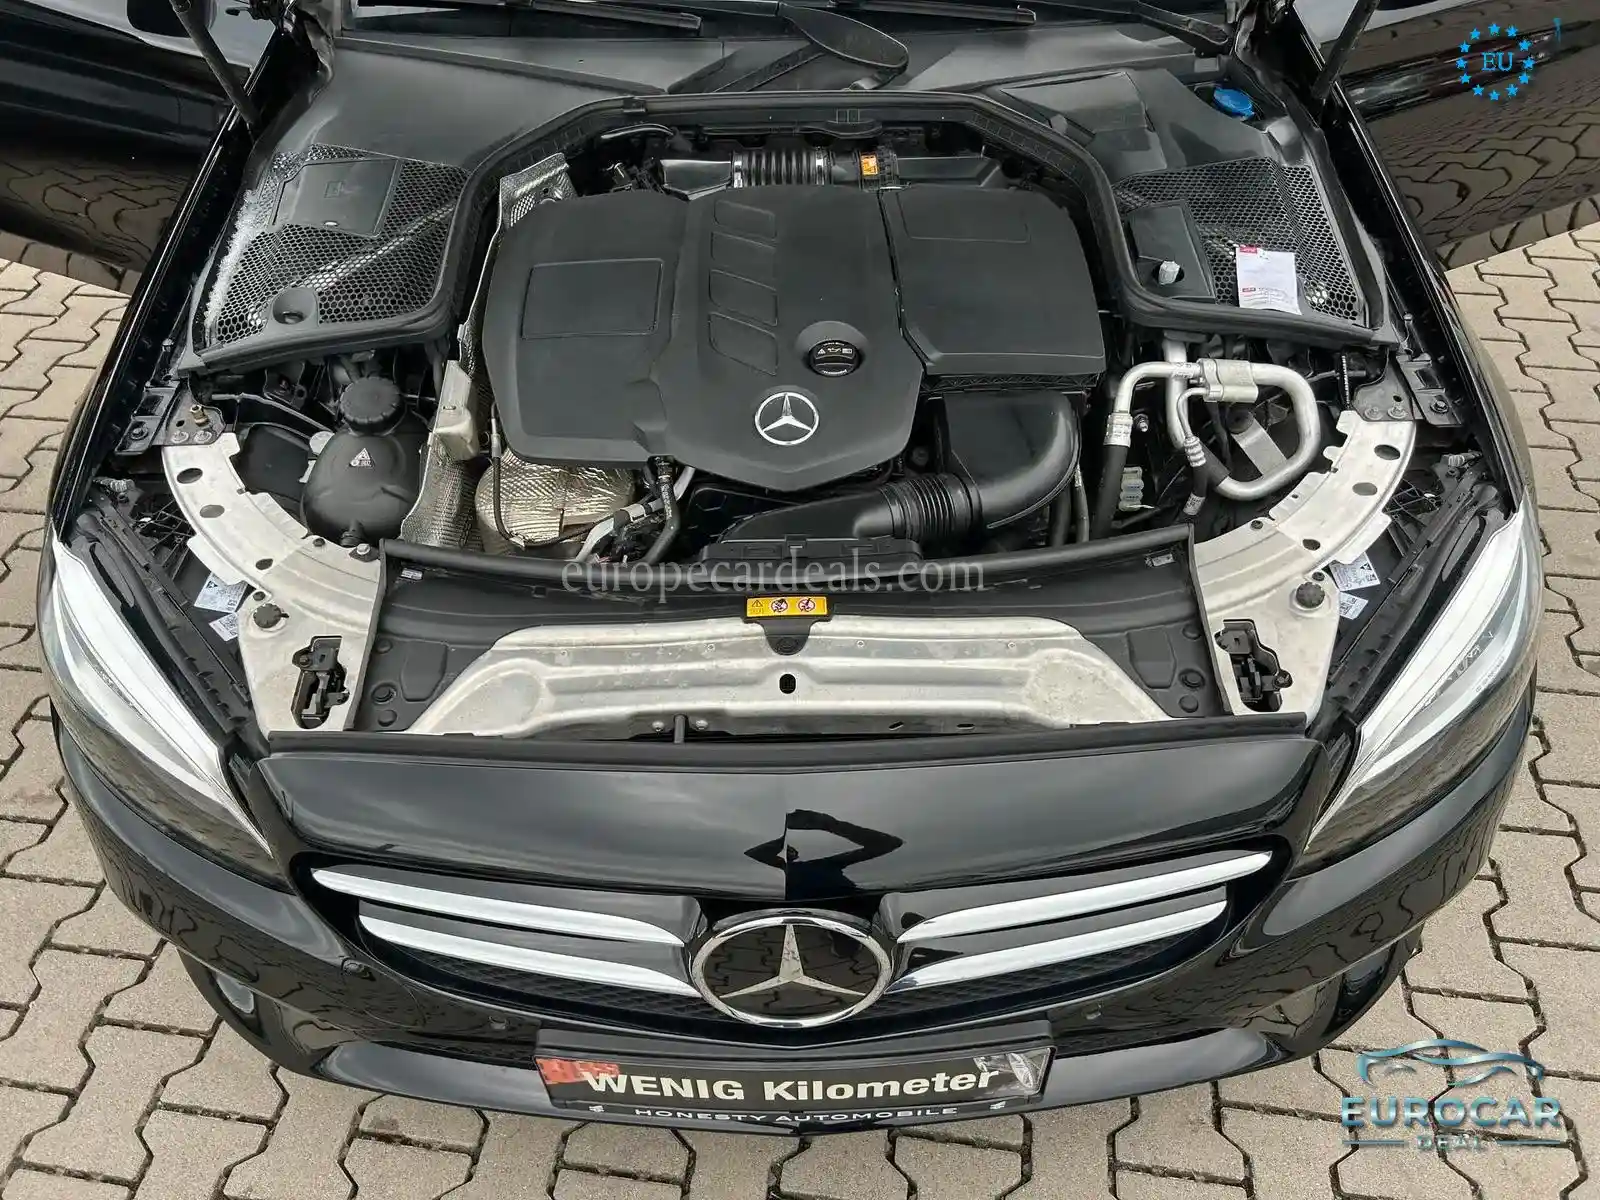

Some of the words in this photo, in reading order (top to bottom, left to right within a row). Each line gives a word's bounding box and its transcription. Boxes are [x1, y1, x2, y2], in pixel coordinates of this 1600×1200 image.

[580, 1071, 745, 1101] WENIG
[763, 1069, 1000, 1101] Kilometer
[634, 1108, 767, 1121] HONESTY
[775, 1107, 958, 1122] AUTOMOBILE
